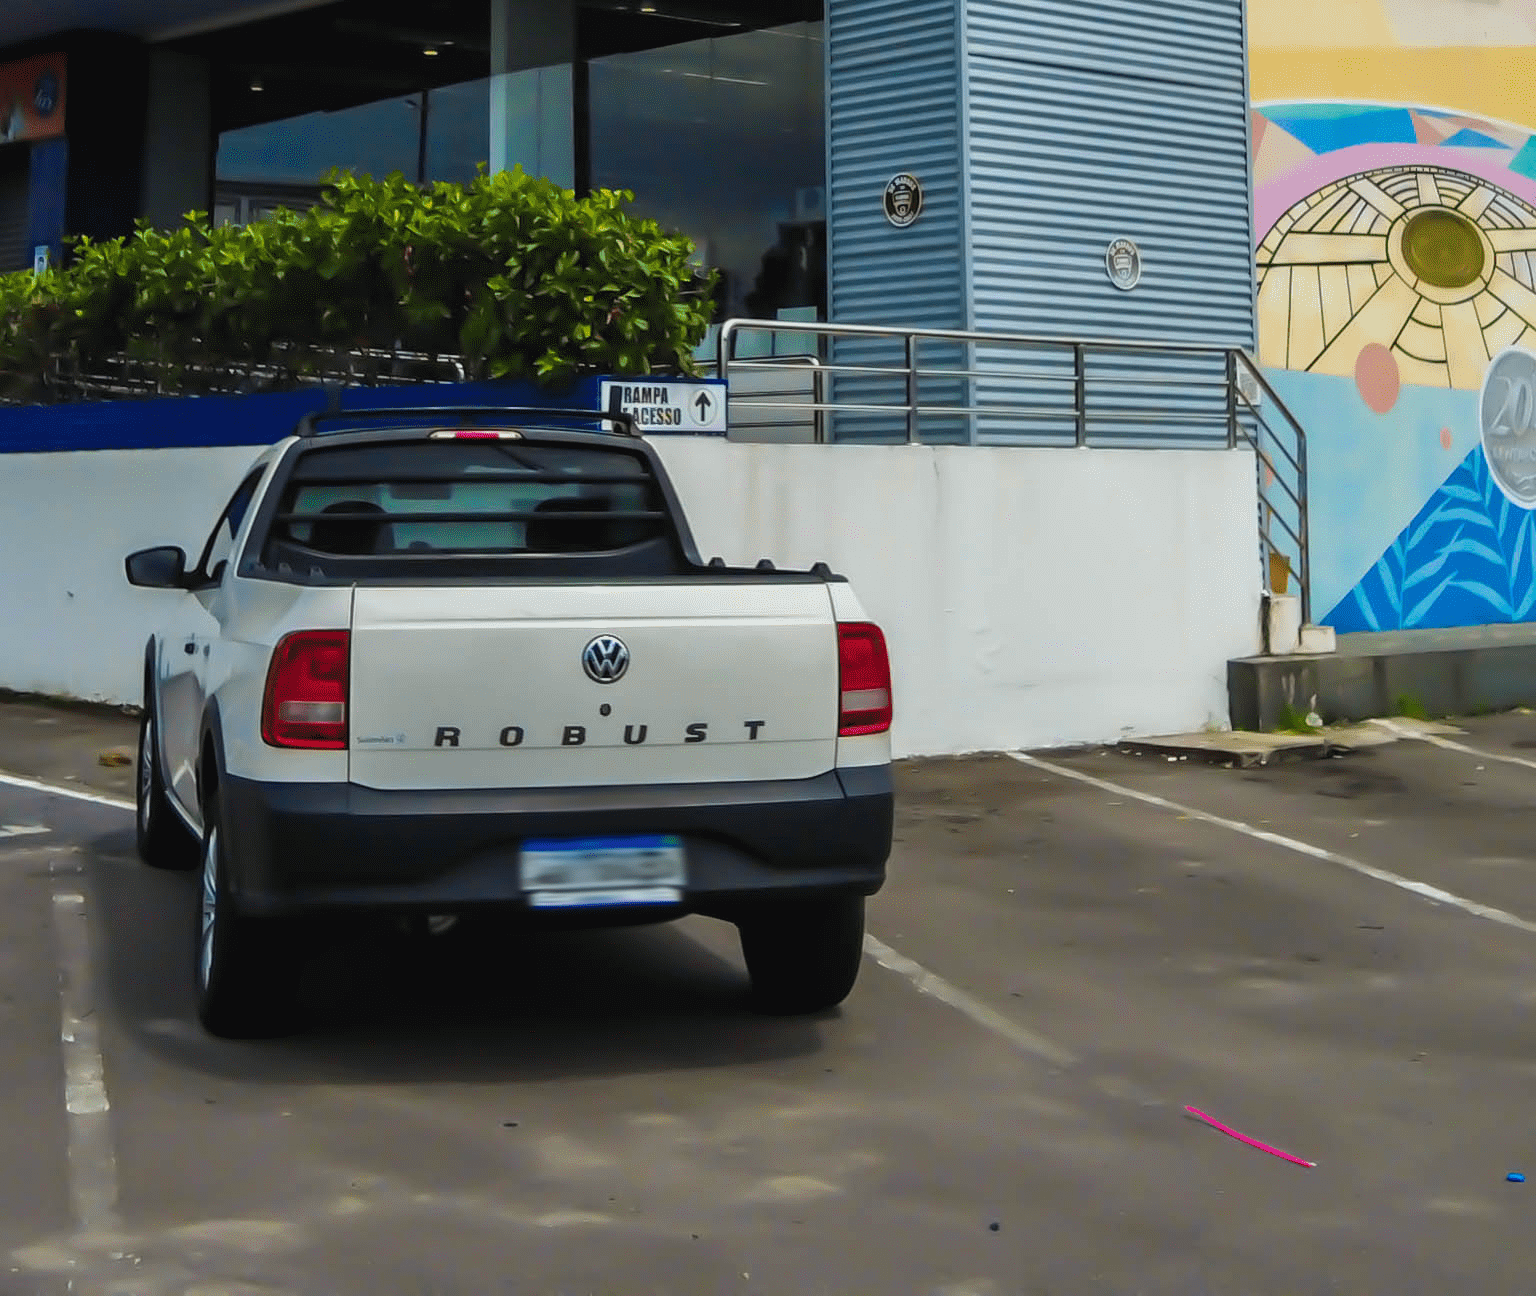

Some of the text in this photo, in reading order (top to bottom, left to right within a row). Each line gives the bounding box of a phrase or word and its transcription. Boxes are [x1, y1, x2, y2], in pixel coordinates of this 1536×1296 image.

[623, 386, 669, 404] RAMPA
[1488, 376, 1534, 436] 20
[632, 407, 682, 426] ACESSO
[434, 720, 765, 748] ROBUST
